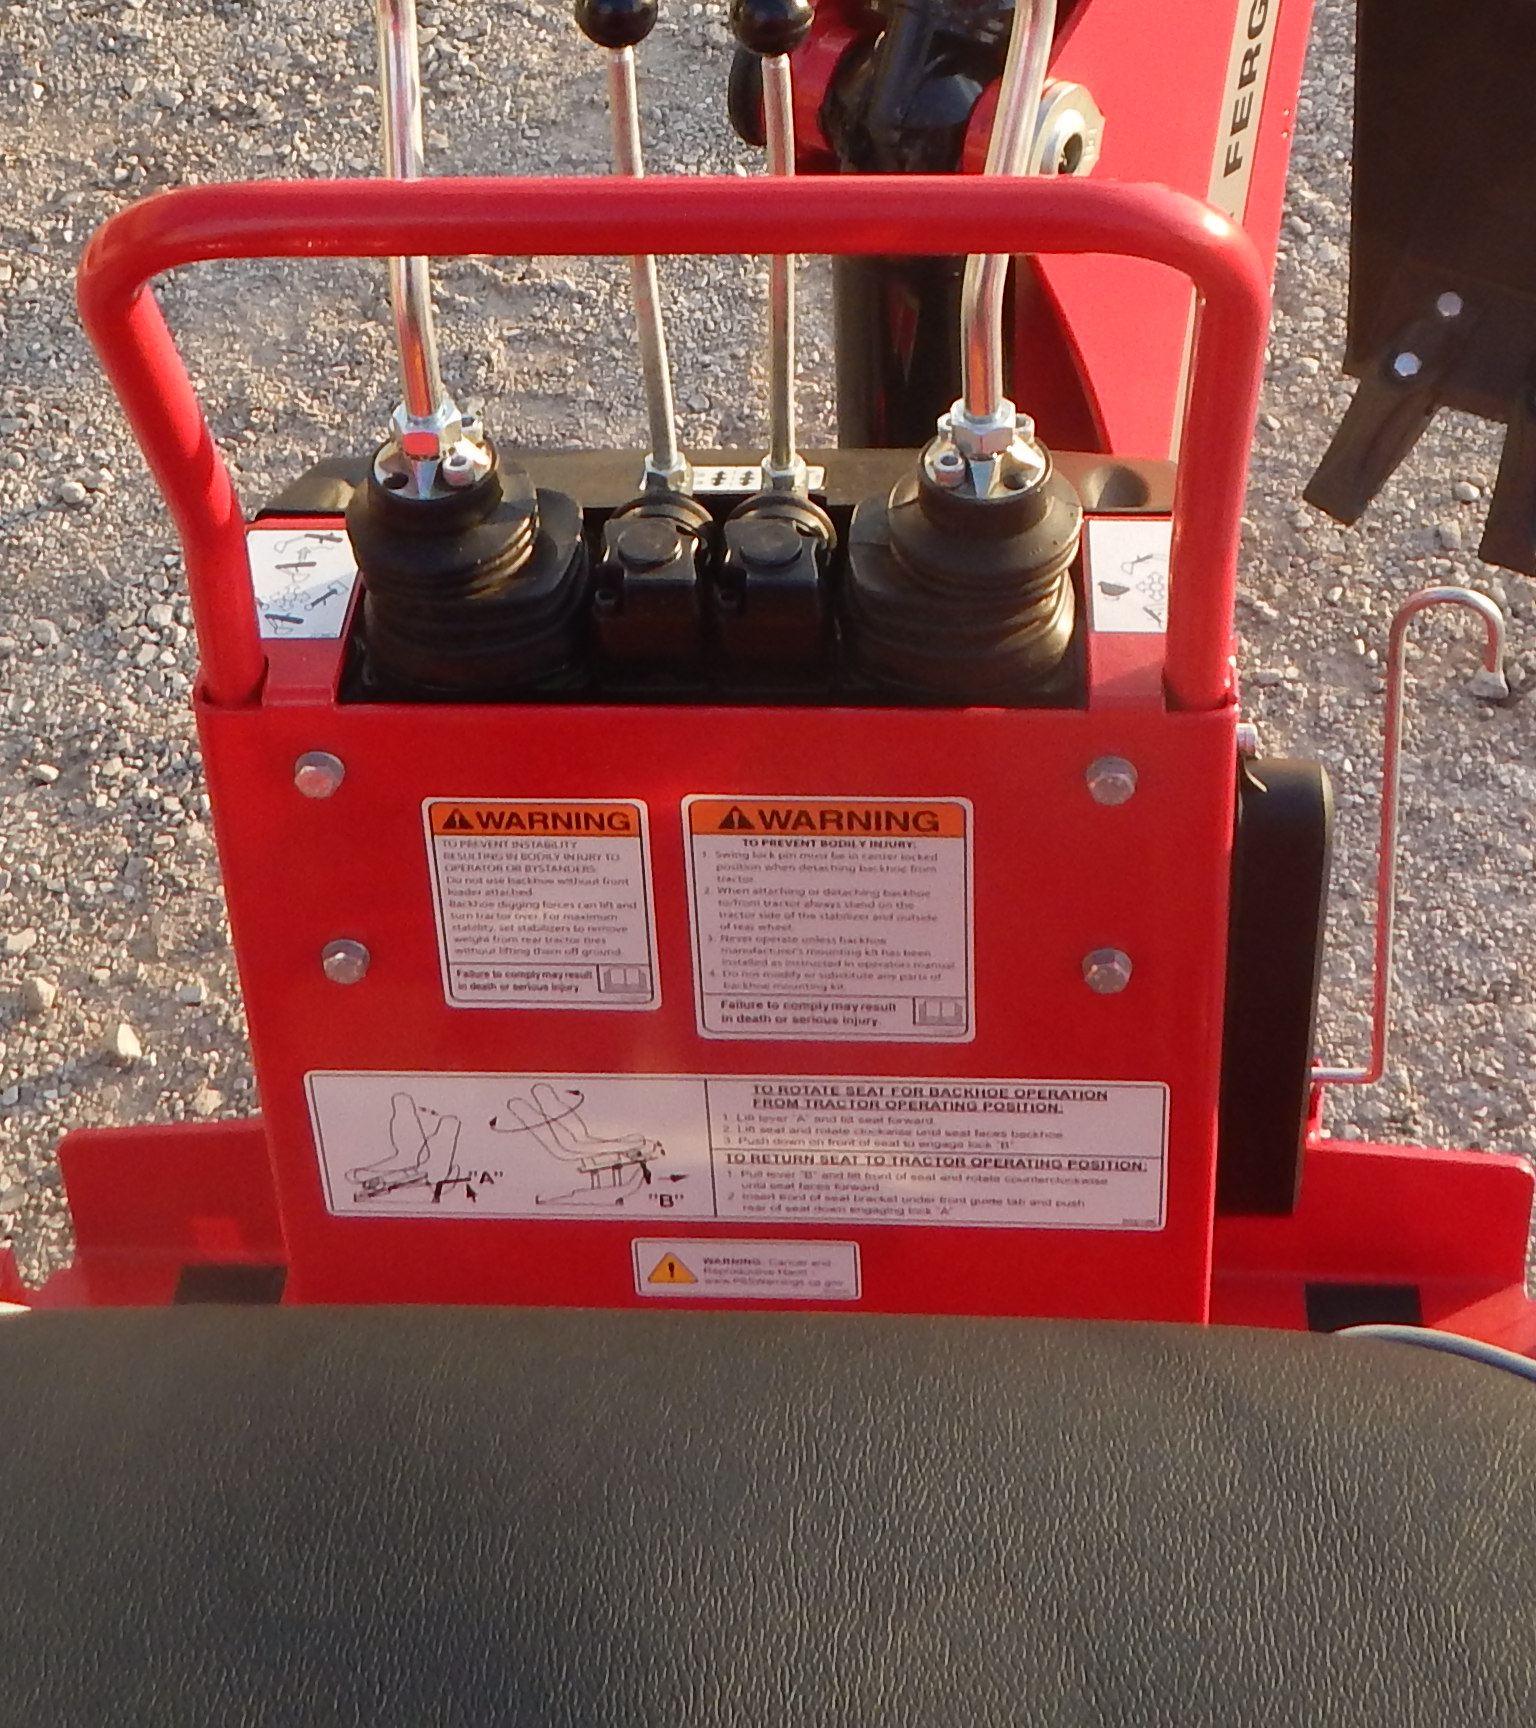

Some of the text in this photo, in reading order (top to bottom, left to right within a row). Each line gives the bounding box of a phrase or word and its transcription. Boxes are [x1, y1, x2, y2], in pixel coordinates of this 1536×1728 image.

[476, 811, 630, 831] WARNING
[758, 809, 939, 834] WARNING
[442, 840, 577, 849] TO PREVENT INSTABILITY
[743, 839, 759, 847] TO
[762, 839, 815, 848] PREVENT
[821, 840, 866, 848] BODILY
[457, 969, 592, 980] Failure to comply may result
[458, 982, 467, 990] in
[470, 982, 497, 991] death
[513, 983, 549, 992] serious
[721, 1000, 896, 1013] Failure to comply may result
[722, 1014, 733, 1023] in
[737, 1014, 771, 1023] death
[775, 1016, 787, 1024] or
[792, 1016, 838, 1025] serious
[754, 1085, 1107, 1101] TO ROTATE SEAT FOR BACKHOE OPERATION
[753, 1098, 799, 1109] FROM
[806, 1099, 881, 1111] TRACTOR
[885, 1098, 978, 1112] OPERATING
[727, 1153, 747, 1165] TO
[750, 1153, 814, 1165] RETURN
[820, 1155, 860, 1166] SEAT
[864, 1156, 887, 1167] TO
[891, 1156, 967, 1168] TRACTOR
[969, 1156, 1063, 1170] OPERATING
[469, 1171, 503, 1185] "A"
[649, 1194, 684, 1208] "B"
